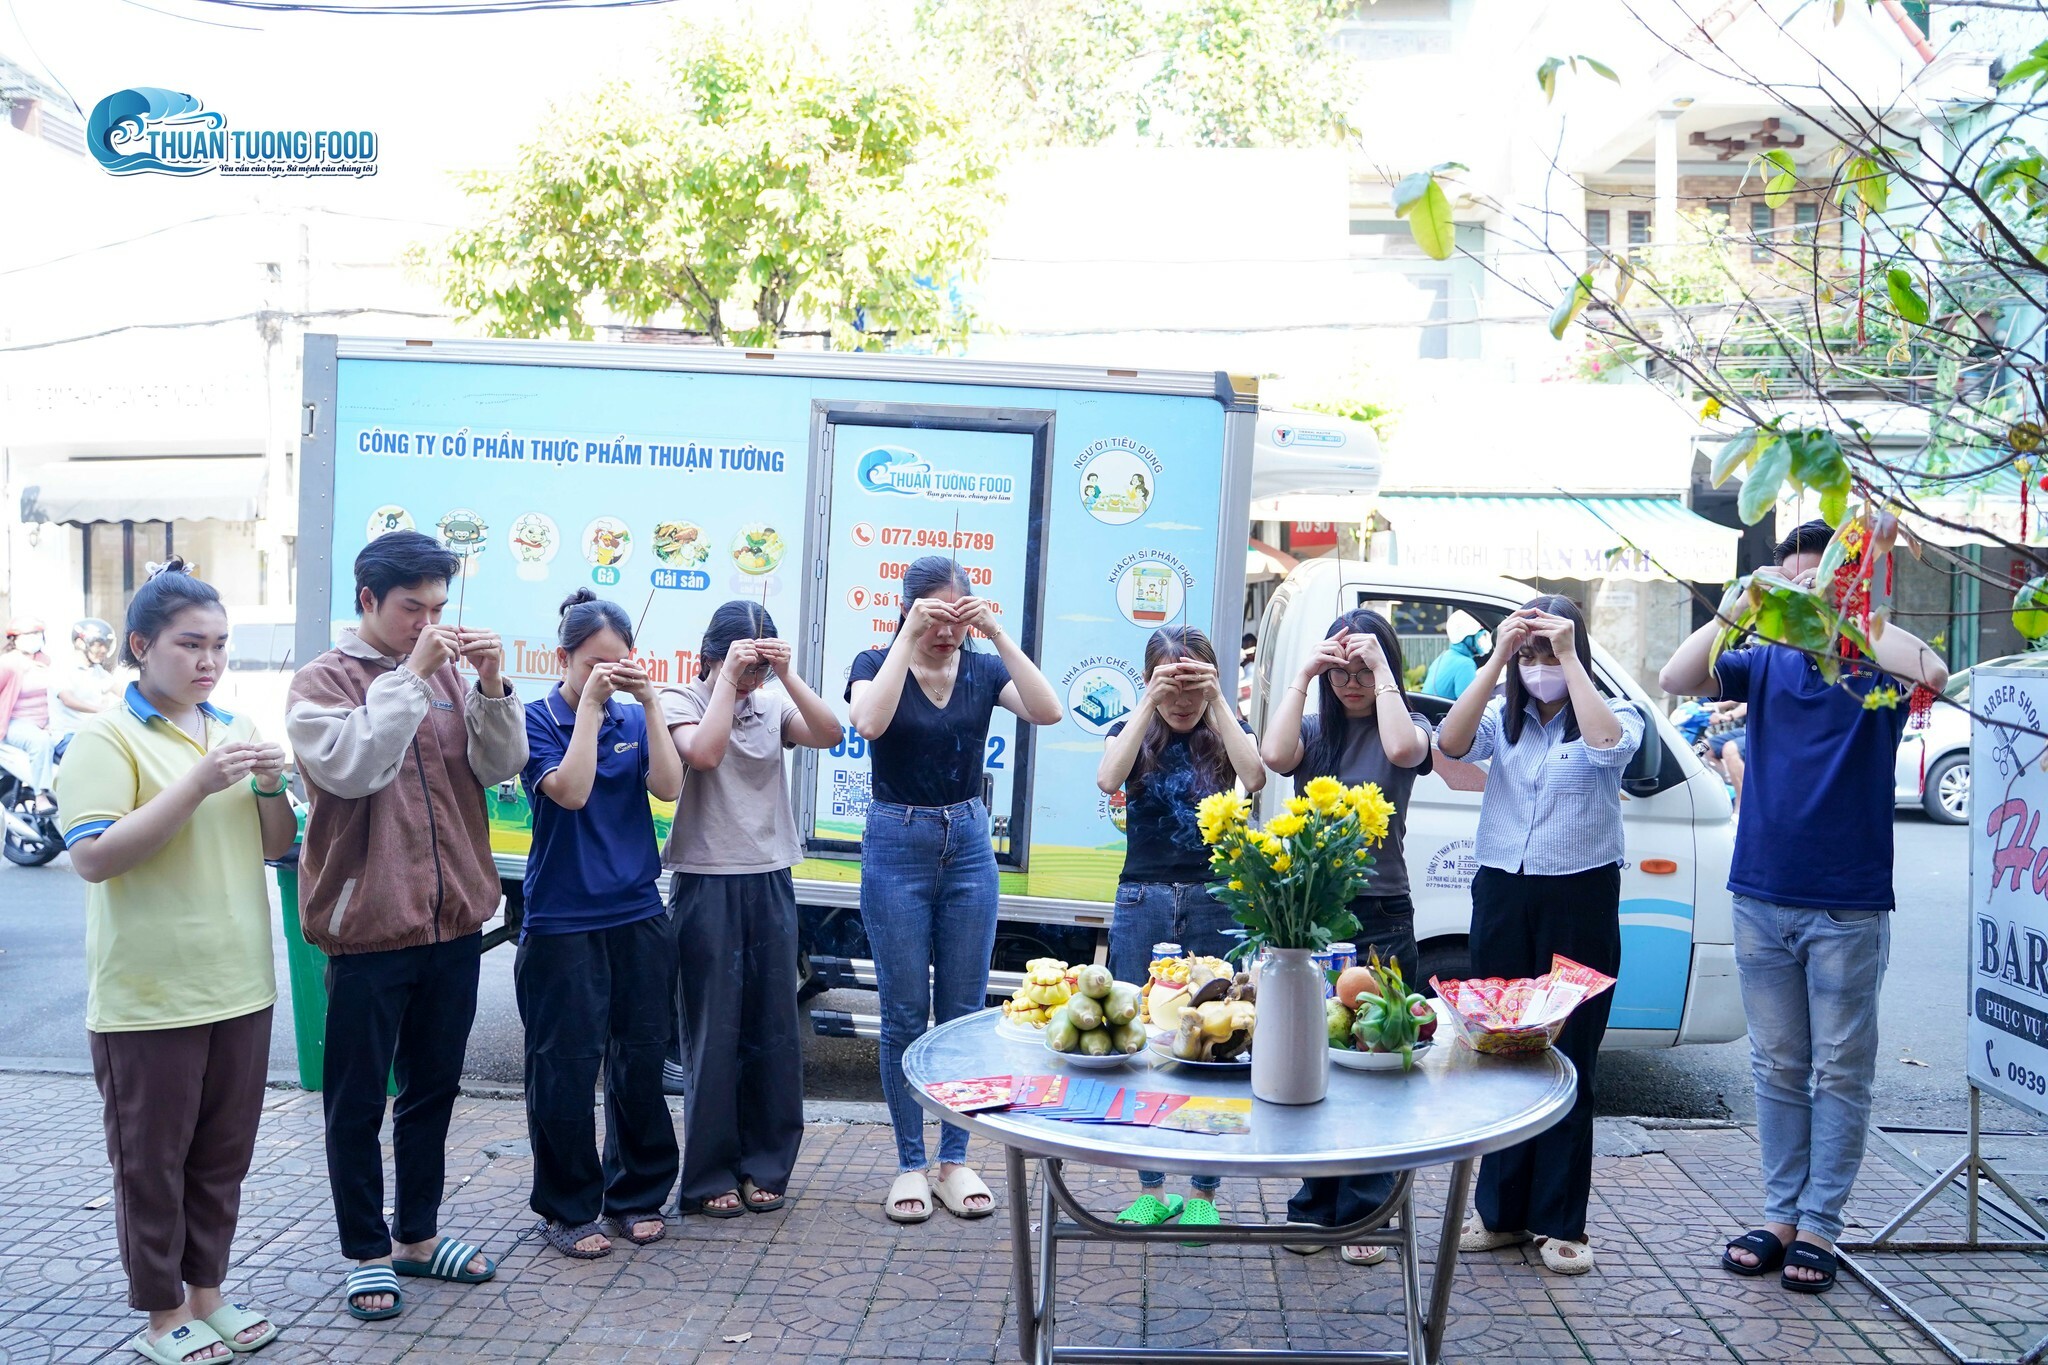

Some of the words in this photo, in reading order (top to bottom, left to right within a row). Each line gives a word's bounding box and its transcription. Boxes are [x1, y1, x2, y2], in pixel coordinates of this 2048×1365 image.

[359, 432, 408, 457] CÔNG
[416, 436, 436, 456] TY
[442, 428, 467, 458] CỔ
[473, 432, 524, 460] PHẦN
[530, 439, 579, 467] THỰC
[585, 433, 642, 466] PHẨM
[648, 444, 712, 473] THUẬN
[719, 445, 784, 473] TƯỜNG
[1111, 436, 1137, 450] TIÊU
[979, 477, 1012, 493] FOOD
[881, 528, 994, 550] 077.949.6789
[597, 567, 615, 584] Gà
[655, 571, 677, 588] Hải
[680, 573, 704, 591] sản
[873, 592, 890, 606] Số
[514, 640, 567, 680] Tườn
[1442, 860, 1455, 870] 3N
[1985, 998, 2019, 1029] PHỤC
[2023, 1013, 2042, 1041] VỤ
